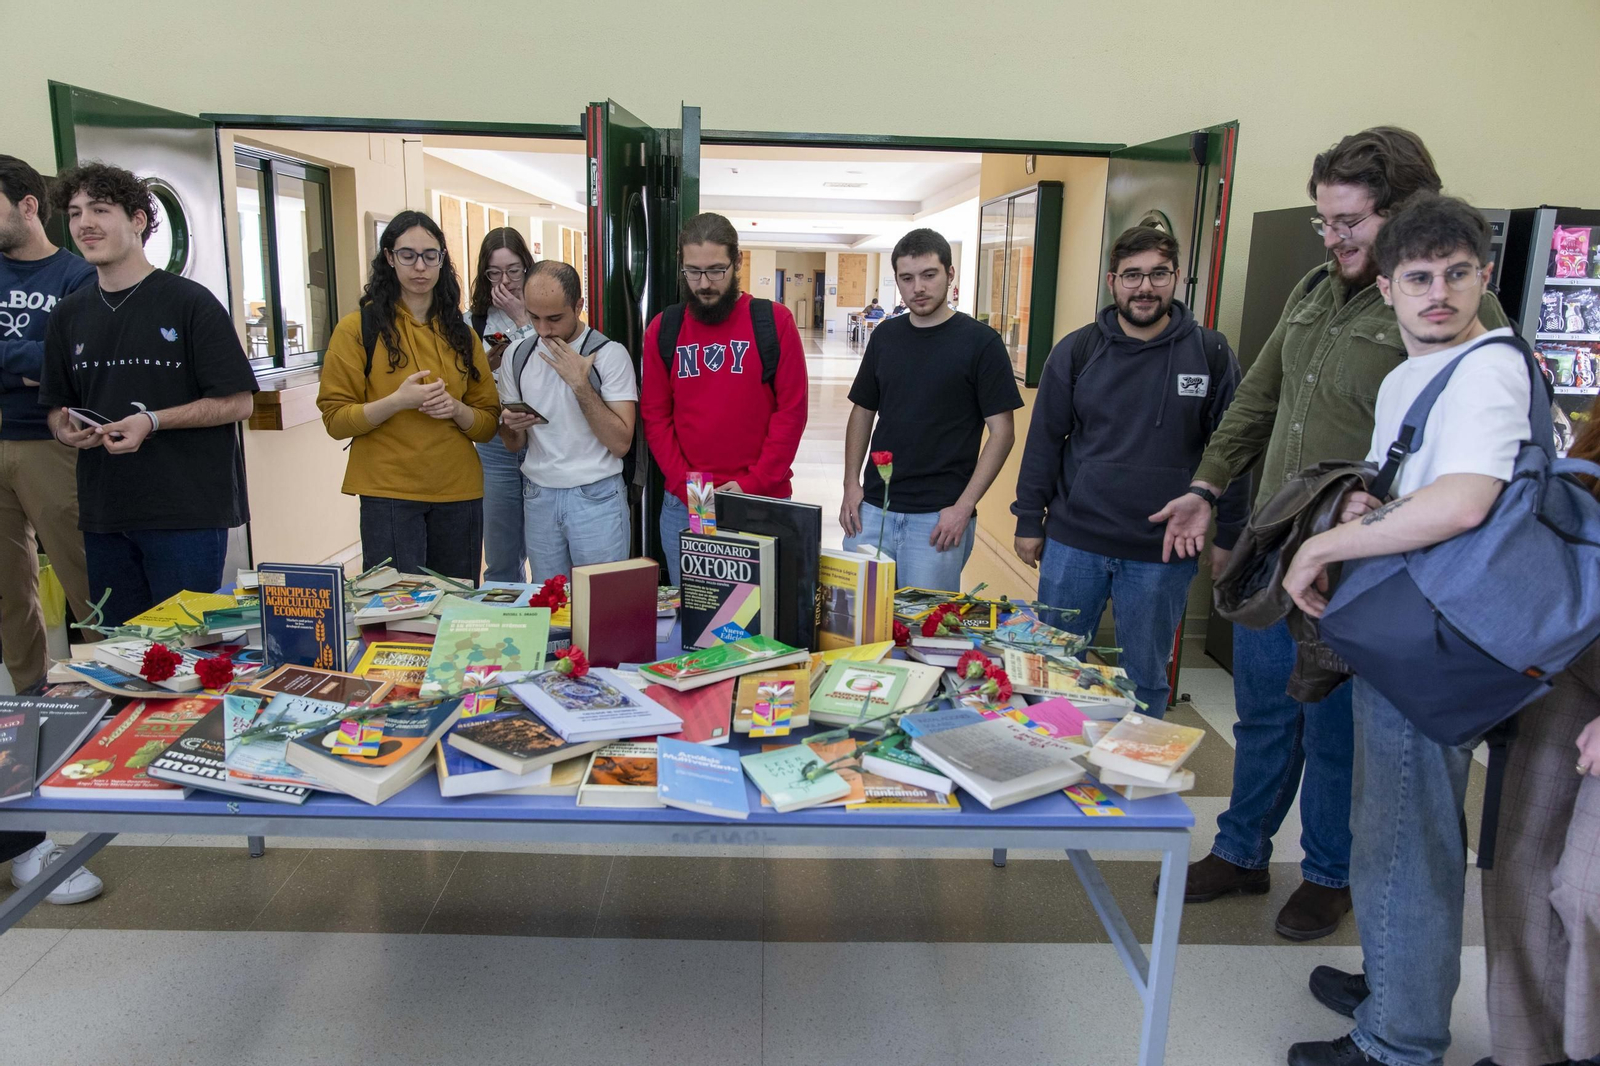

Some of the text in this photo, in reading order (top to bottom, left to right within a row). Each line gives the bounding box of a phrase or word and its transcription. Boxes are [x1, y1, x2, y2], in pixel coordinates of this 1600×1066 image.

[681, 540, 751, 558] DICCIONARIO
[680, 554, 752, 582] OXFORD
[265, 585, 332, 599] PRINCIPLES OF
[265, 595, 332, 610] AGRICULTURAL
[273, 606, 326, 619] ECONOMICS
[720, 633, 744, 642] Edició
[722, 626, 744, 636] Nueva
[20, 700, 34, 708] de
[854, 698, 889, 706] SYTEM
[165, 750, 226, 769] manue
[662, 752, 739, 773] Multivariante
[678, 751, 720, 764] Análisis
[865, 789, 928, 798] tankamón
